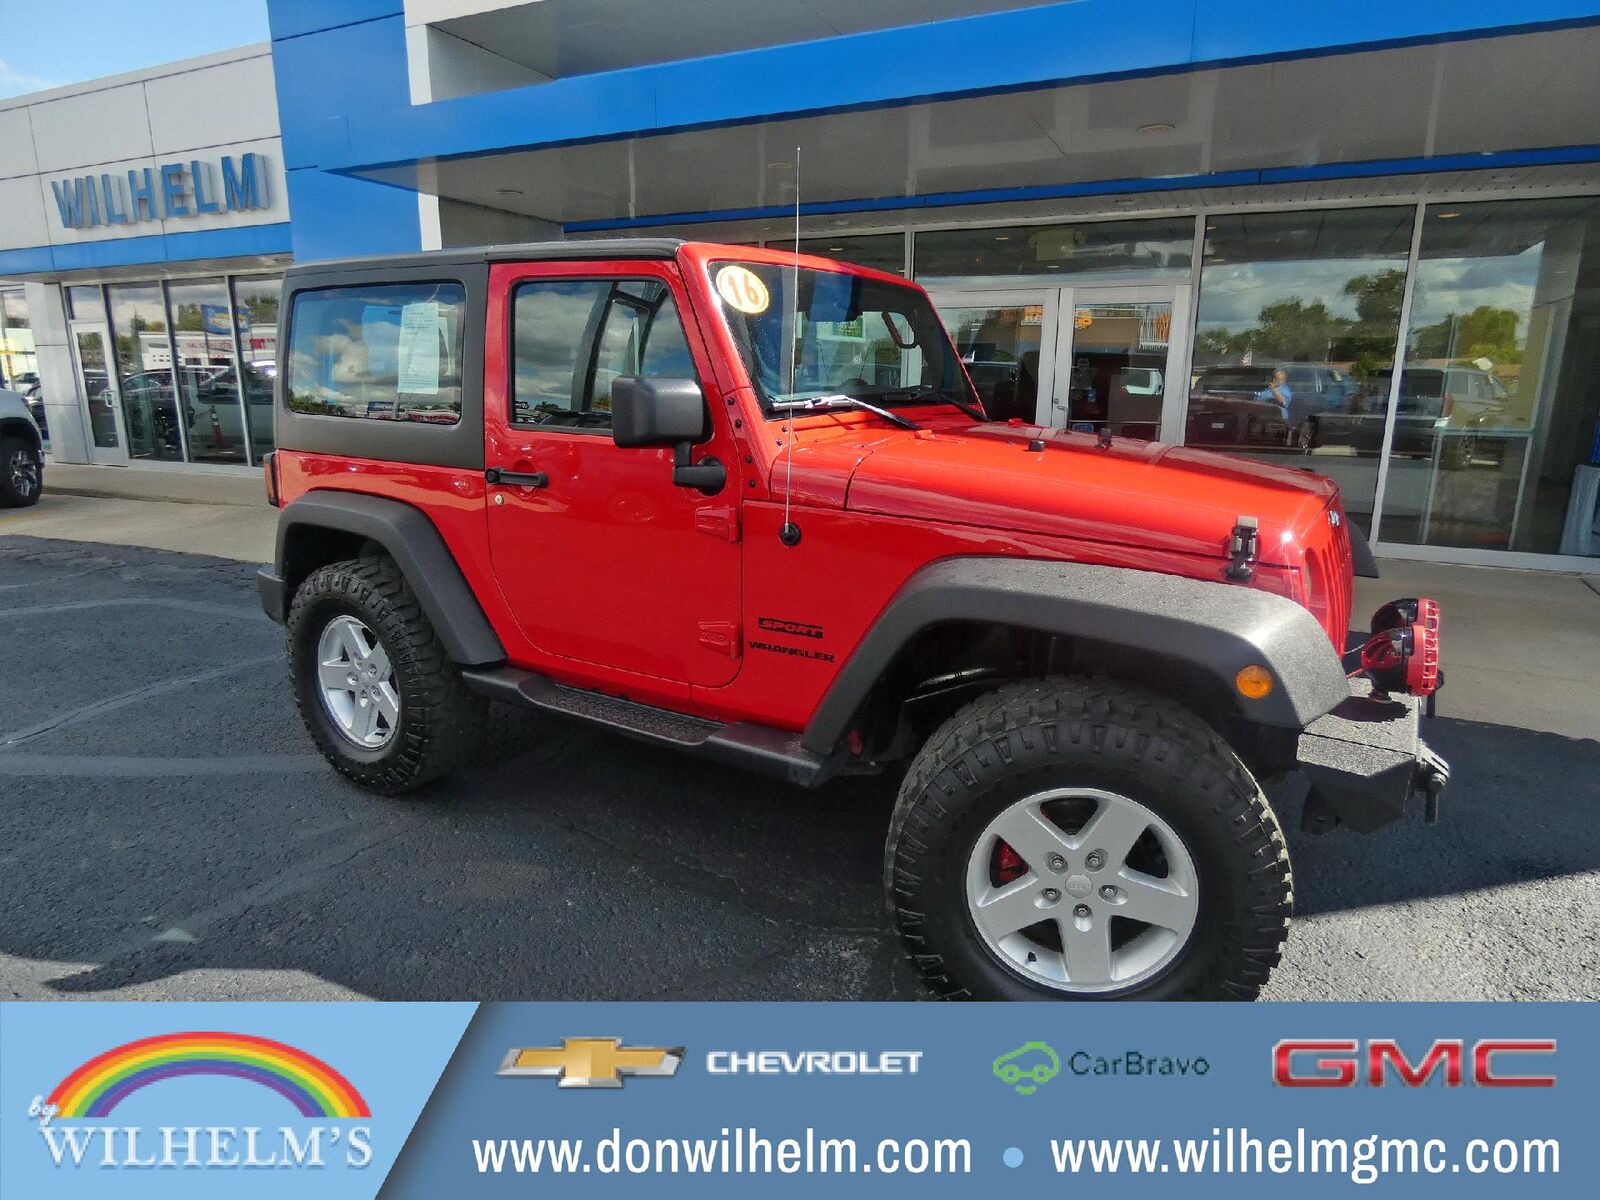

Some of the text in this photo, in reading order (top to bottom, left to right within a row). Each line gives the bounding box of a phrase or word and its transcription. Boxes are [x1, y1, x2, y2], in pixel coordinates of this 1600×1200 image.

[52, 152, 266, 229] WILHELM
[727, 273, 759, 306] 16
[758, 617, 823, 638] SPORT
[749, 641, 835, 663] WRANGLER
